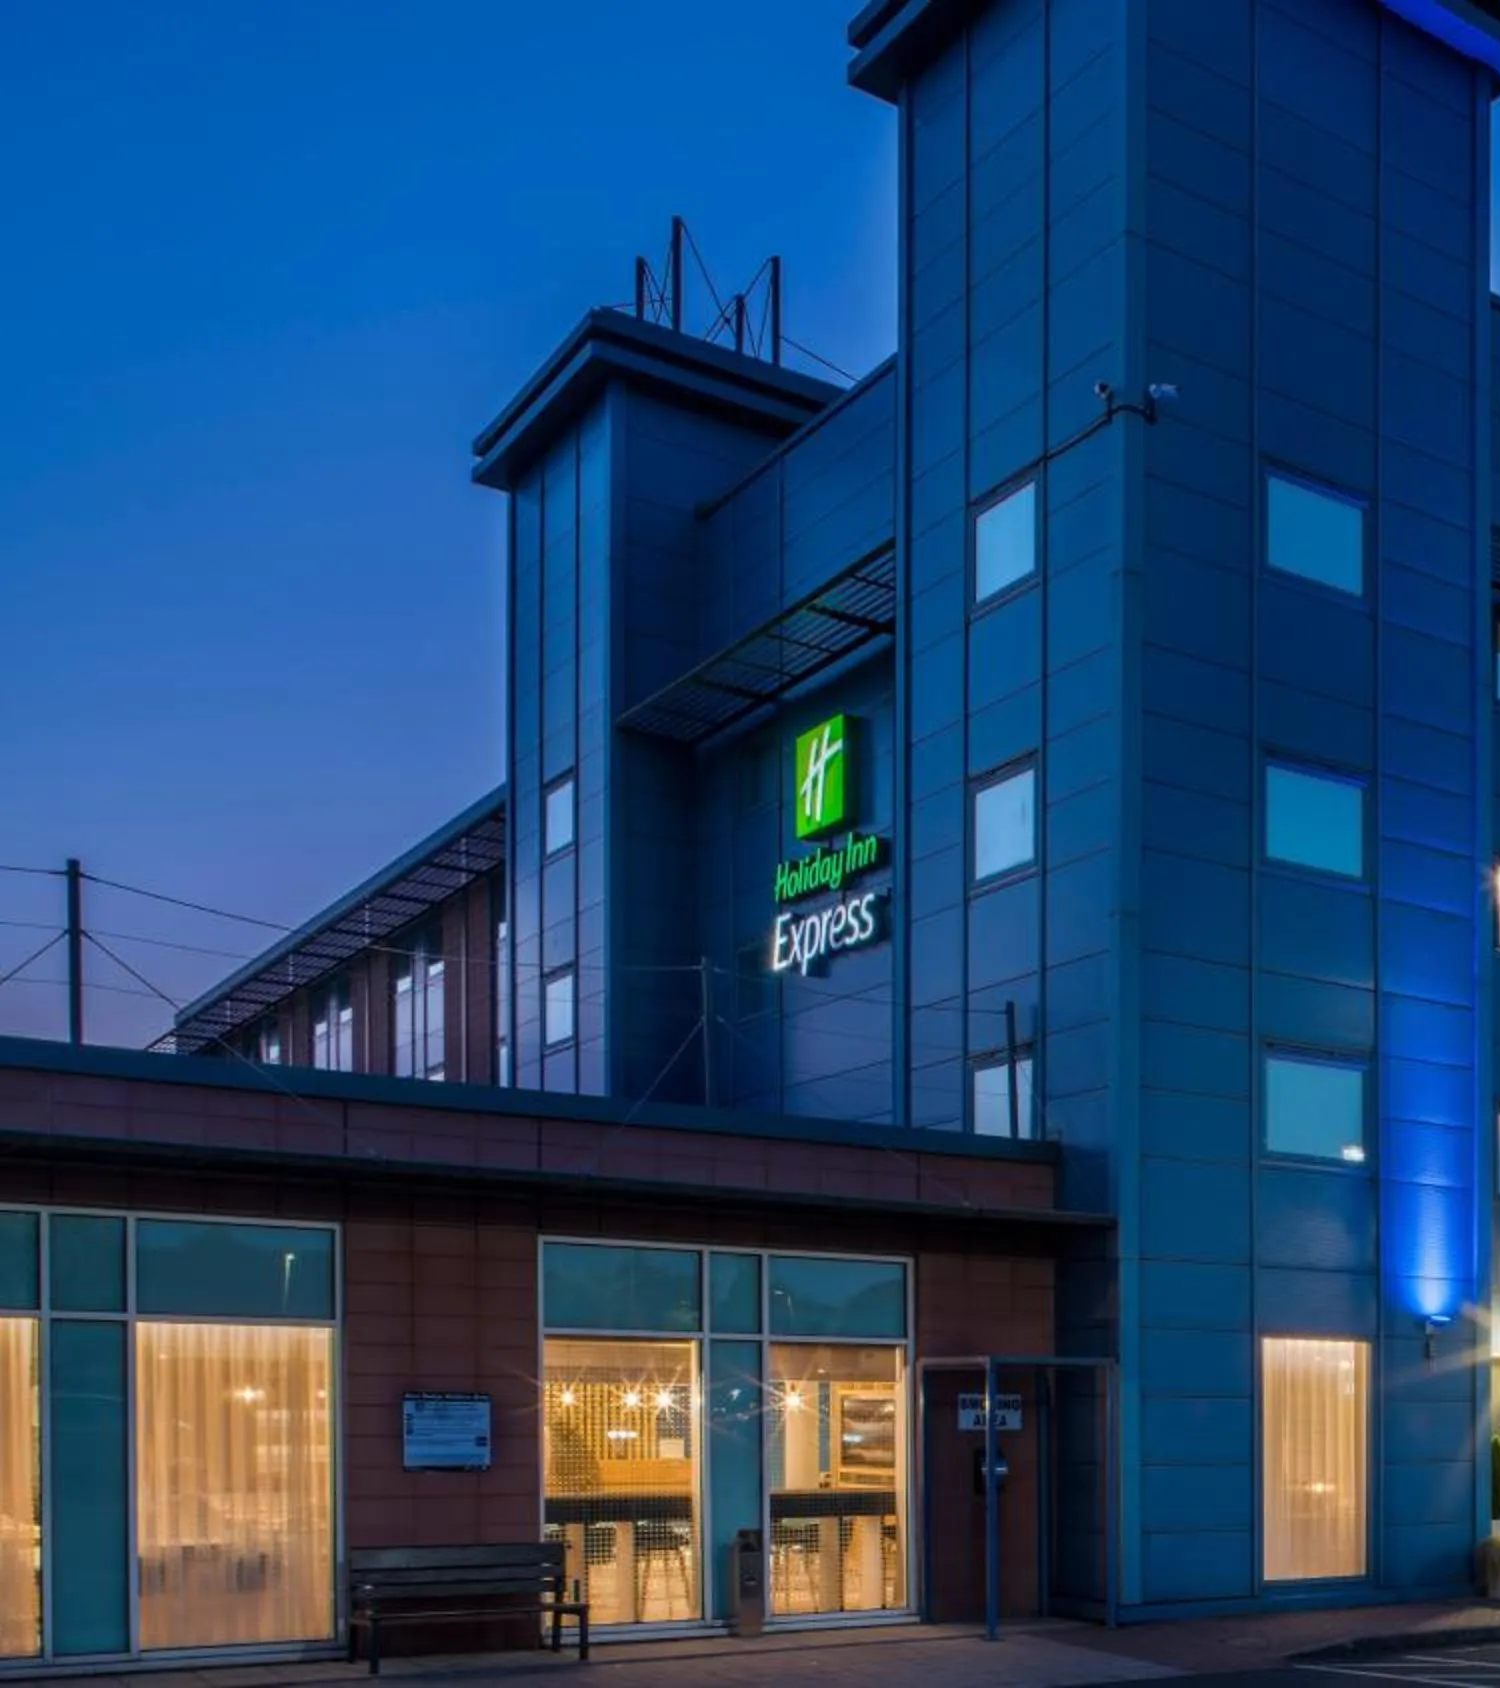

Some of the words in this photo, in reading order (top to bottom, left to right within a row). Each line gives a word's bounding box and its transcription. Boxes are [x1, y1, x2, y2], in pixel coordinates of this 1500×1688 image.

[774, 847, 844, 902] Holiday
[845, 832, 877, 870] Inn
[771, 892, 876, 976] Express
[961, 1398, 1021, 1411] SMOING
